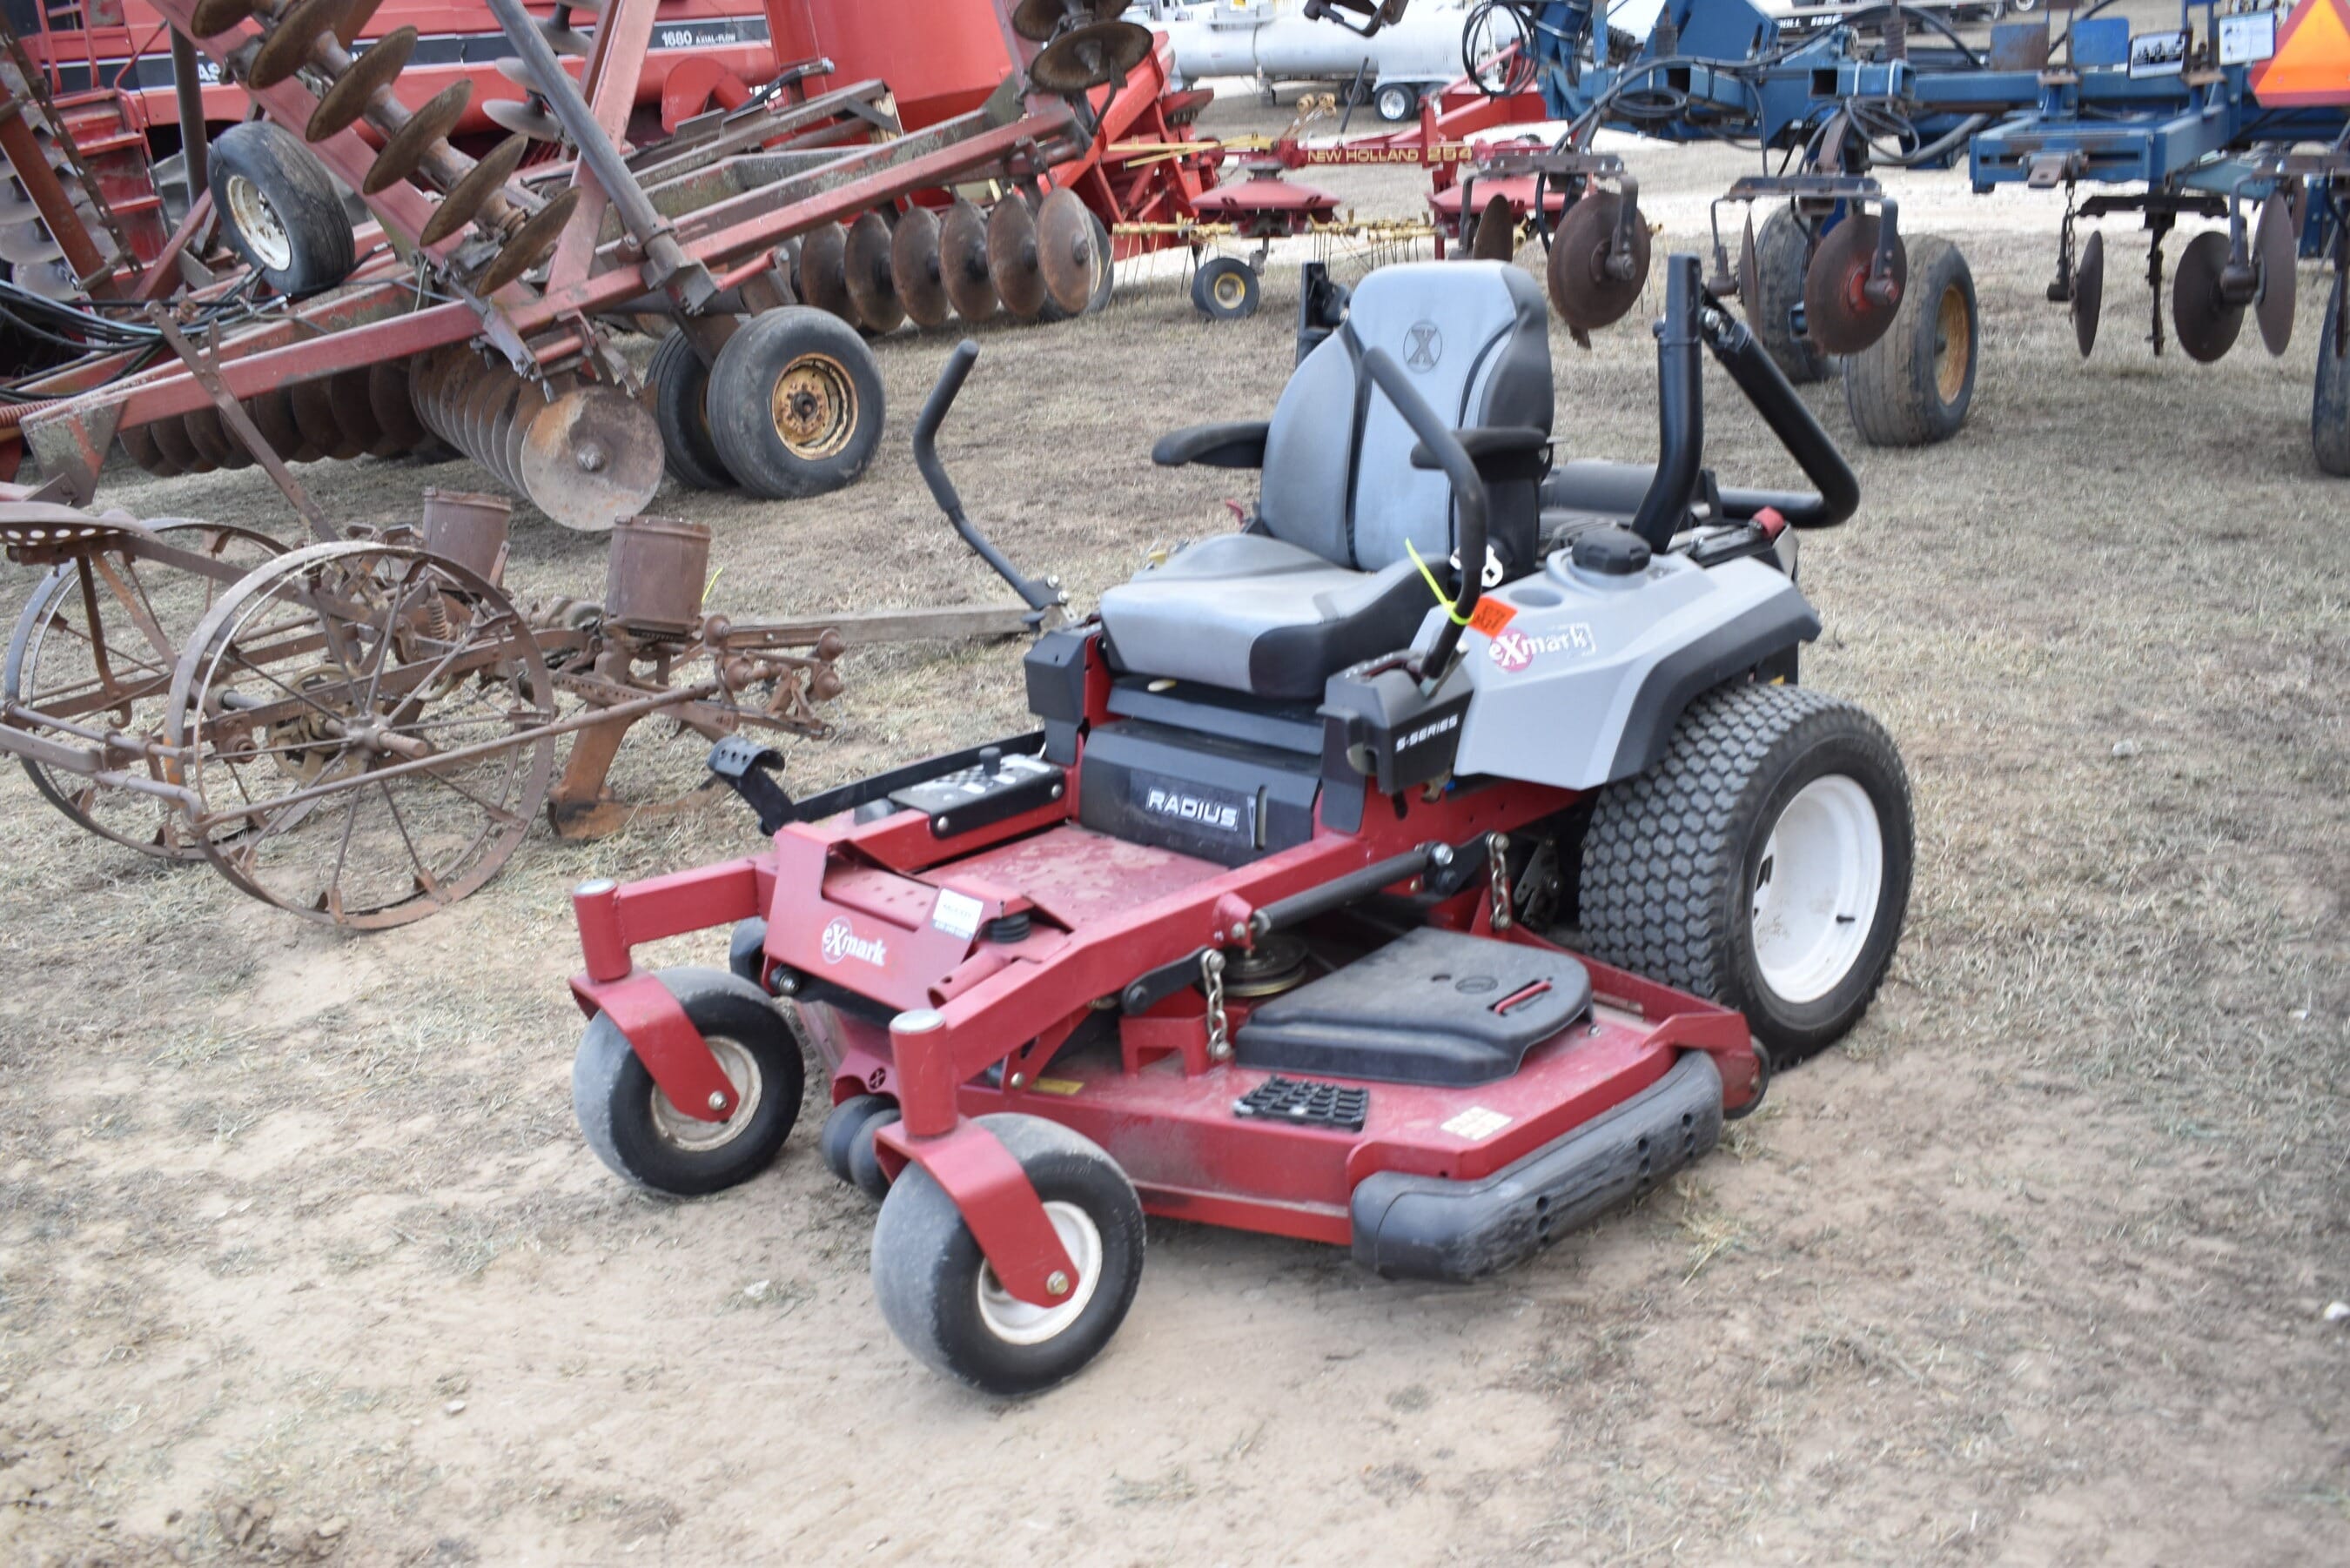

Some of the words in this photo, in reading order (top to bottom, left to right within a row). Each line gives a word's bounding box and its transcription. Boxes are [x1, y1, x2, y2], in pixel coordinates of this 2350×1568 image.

[661, 30, 693, 47] 1680
[1308, 150, 1341, 163] NEW
[1346, 148, 1419, 163] HOLLAND
[1146, 787, 1239, 831] RADIUS
